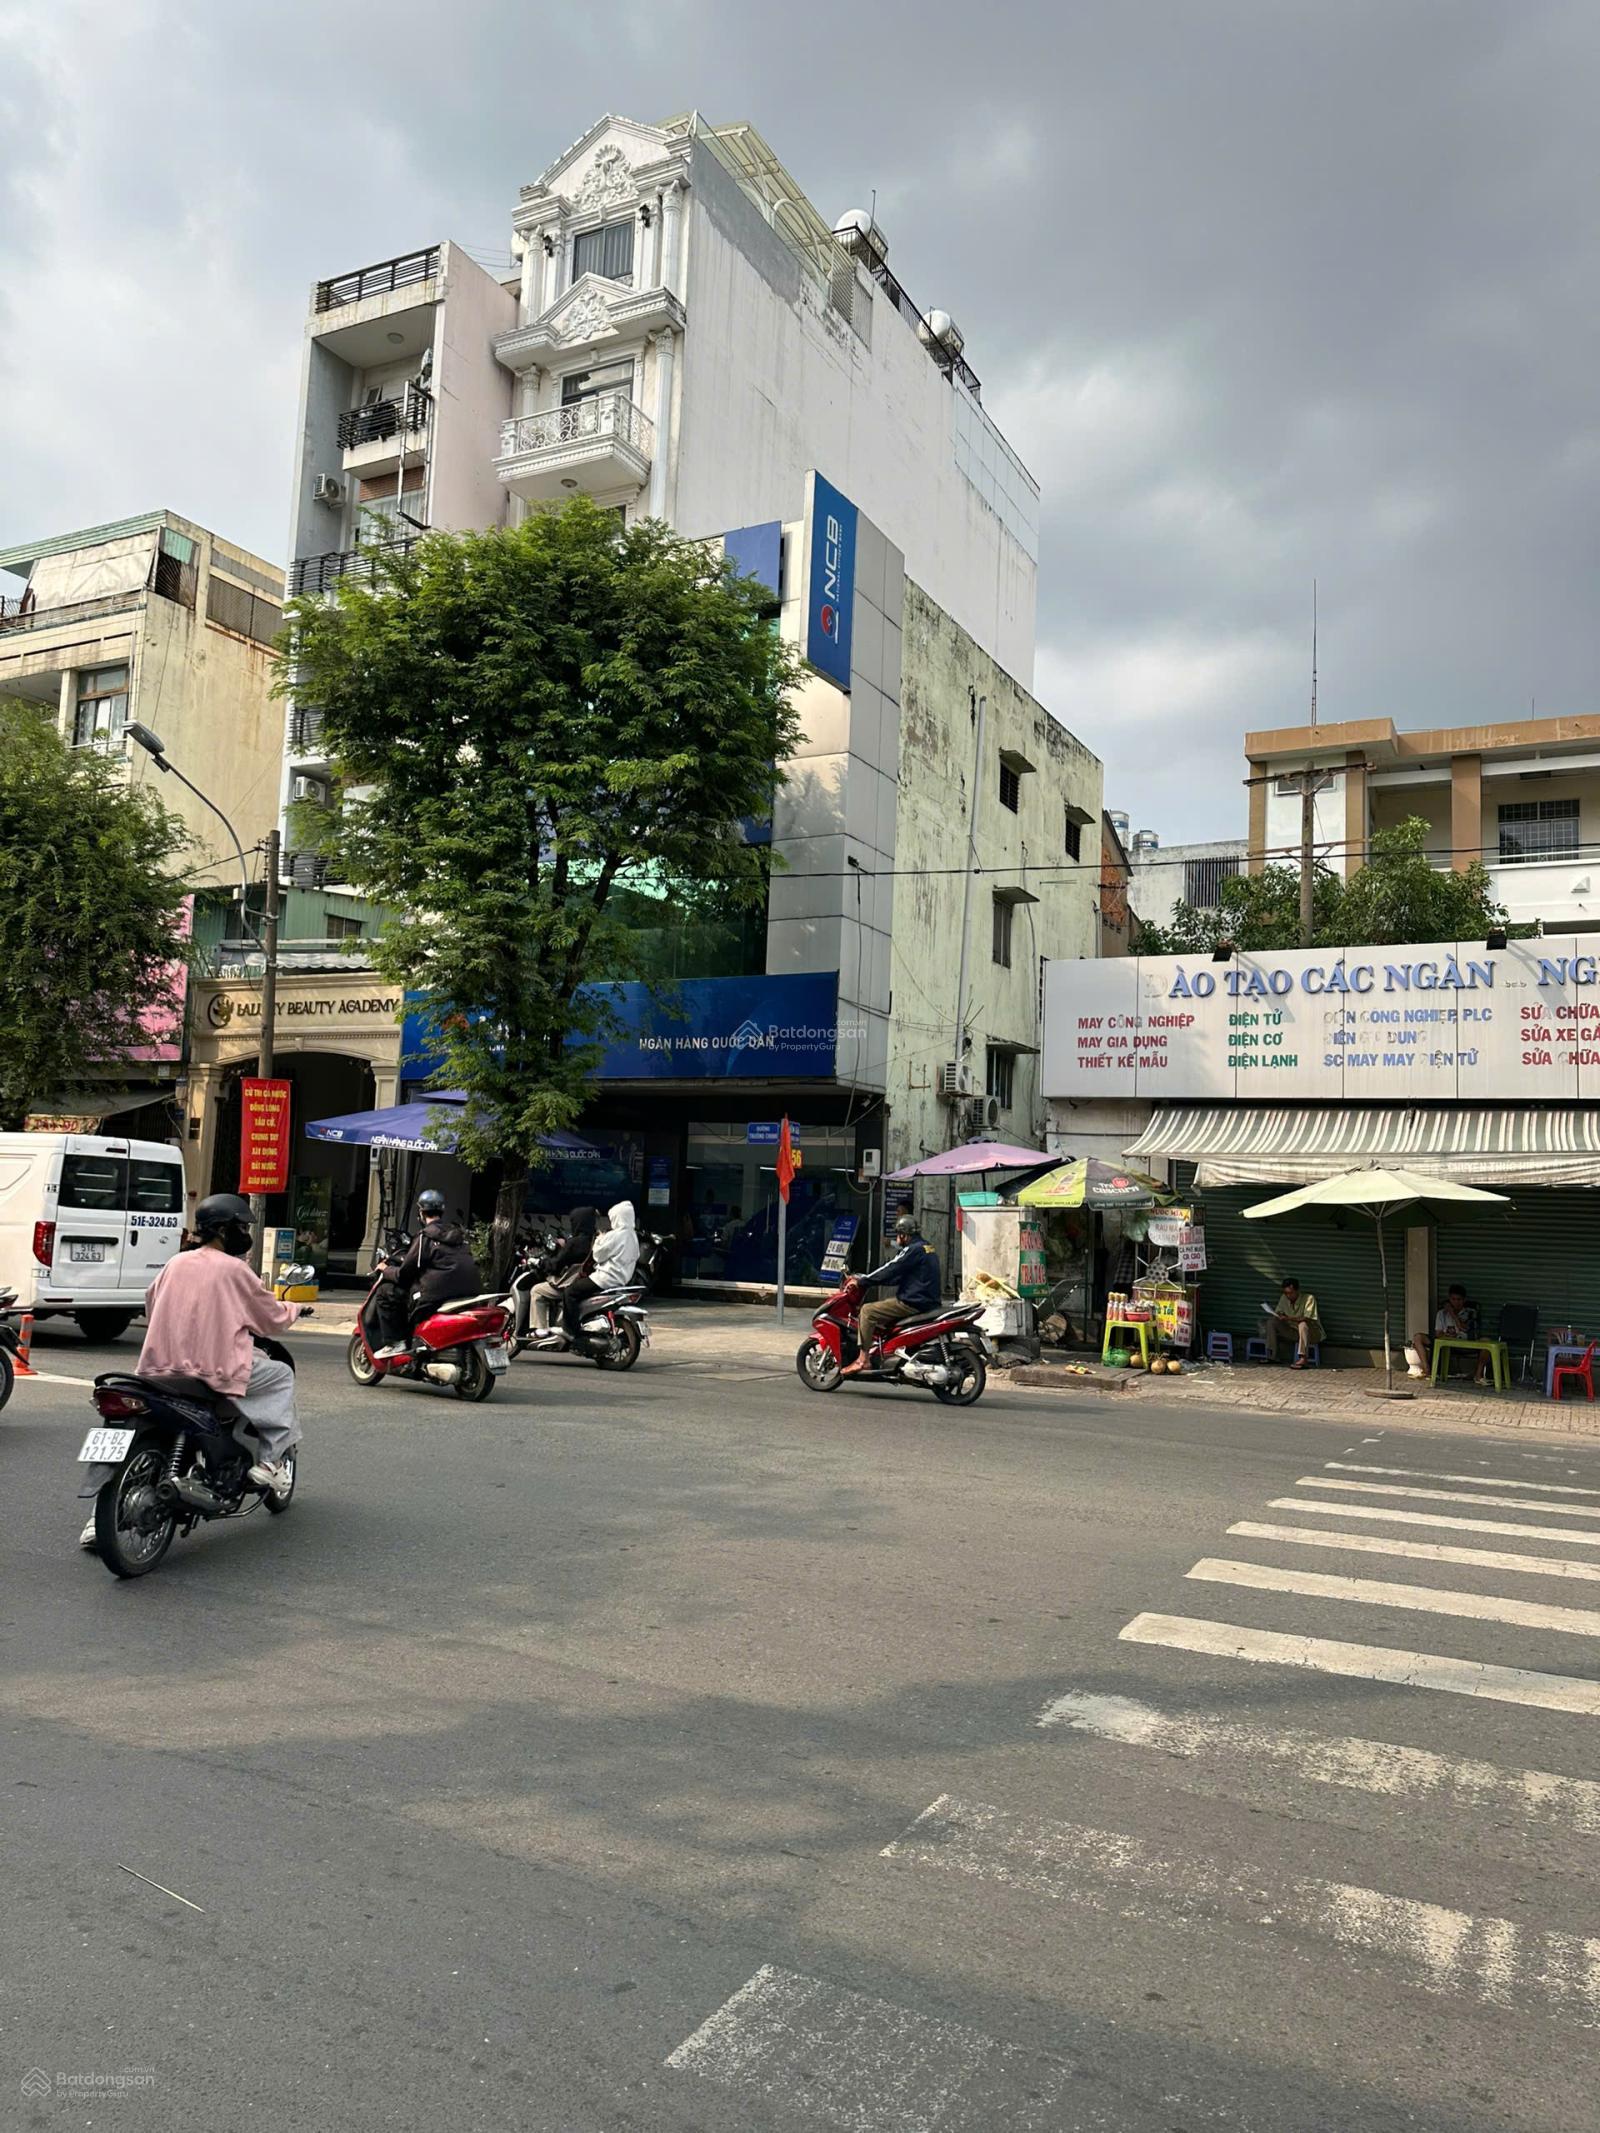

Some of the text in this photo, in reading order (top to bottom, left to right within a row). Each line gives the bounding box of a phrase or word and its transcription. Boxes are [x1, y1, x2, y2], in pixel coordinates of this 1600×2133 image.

[824, 515, 838, 600] NCB
[1224, 969, 1293, 1002] TẠO
[1301, 958, 1374, 994] CÁC
[1537, 955, 1600, 987] NG
[287, 1000, 336, 1015] BEAUTY
[1463, 1008, 1493, 1022] PLC
[1078, 1017, 1103, 1029] MAY
[1148, 1012, 1195, 1029] NGHIỆP
[1229, 1008, 1283, 1027] ĐIỆN TỬ
[1228, 1032, 1283, 1047] ĐIỆN CƠ
[1520, 1023, 1552, 1042] SỬA
[1555, 1028, 1577, 1042] XE
[639, 1035, 672, 1050] NGÂN
[675, 1034, 709, 1049] HÀNG
[1077, 1035, 1168, 1050] MAY GIA DỤNG
[1078, 1051, 1168, 1068] THIẾT KẾ MẪU
[1228, 1052, 1298, 1069] ĐIỆN LẠNH
[1323, 1053, 1344, 1067] SC
[1457, 1047, 1479, 1066] TỬ
[1522, 1047, 1552, 1065] SỬA
[130, 1215, 178, 1228] 51E-324.63
[83, 1446, 125, 1460] 121.75
